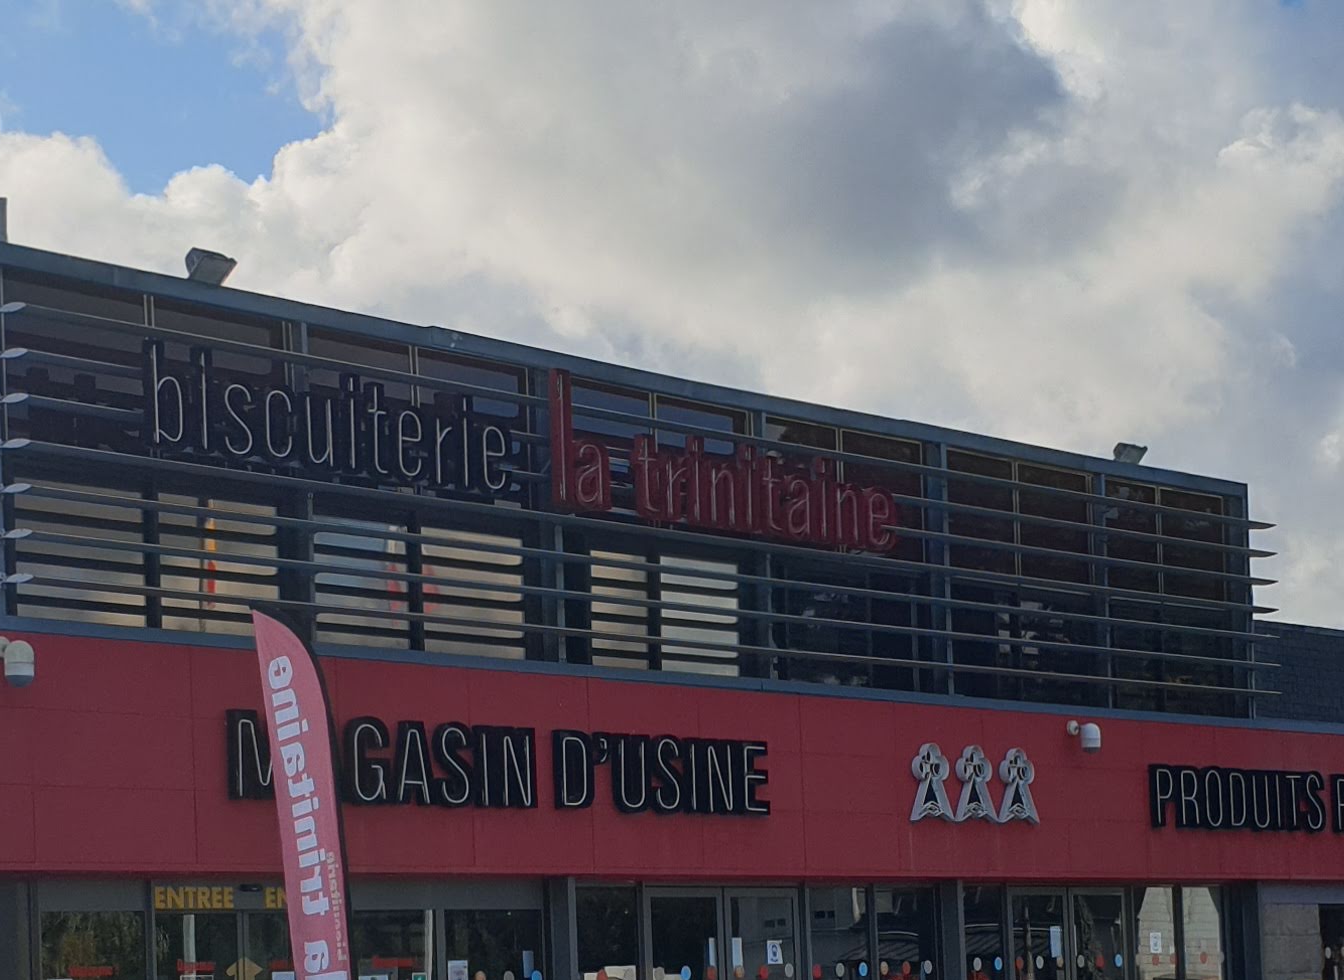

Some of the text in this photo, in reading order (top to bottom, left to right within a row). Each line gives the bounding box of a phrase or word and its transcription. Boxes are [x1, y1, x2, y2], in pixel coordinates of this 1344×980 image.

[144, 340, 897, 552] biscuiterie la trinitaine
[226, 709, 770, 815] MGASIN D'USINE
[1148, 764, 1325, 832] PRODUITS
[155, 886, 235, 910] ENTREE
